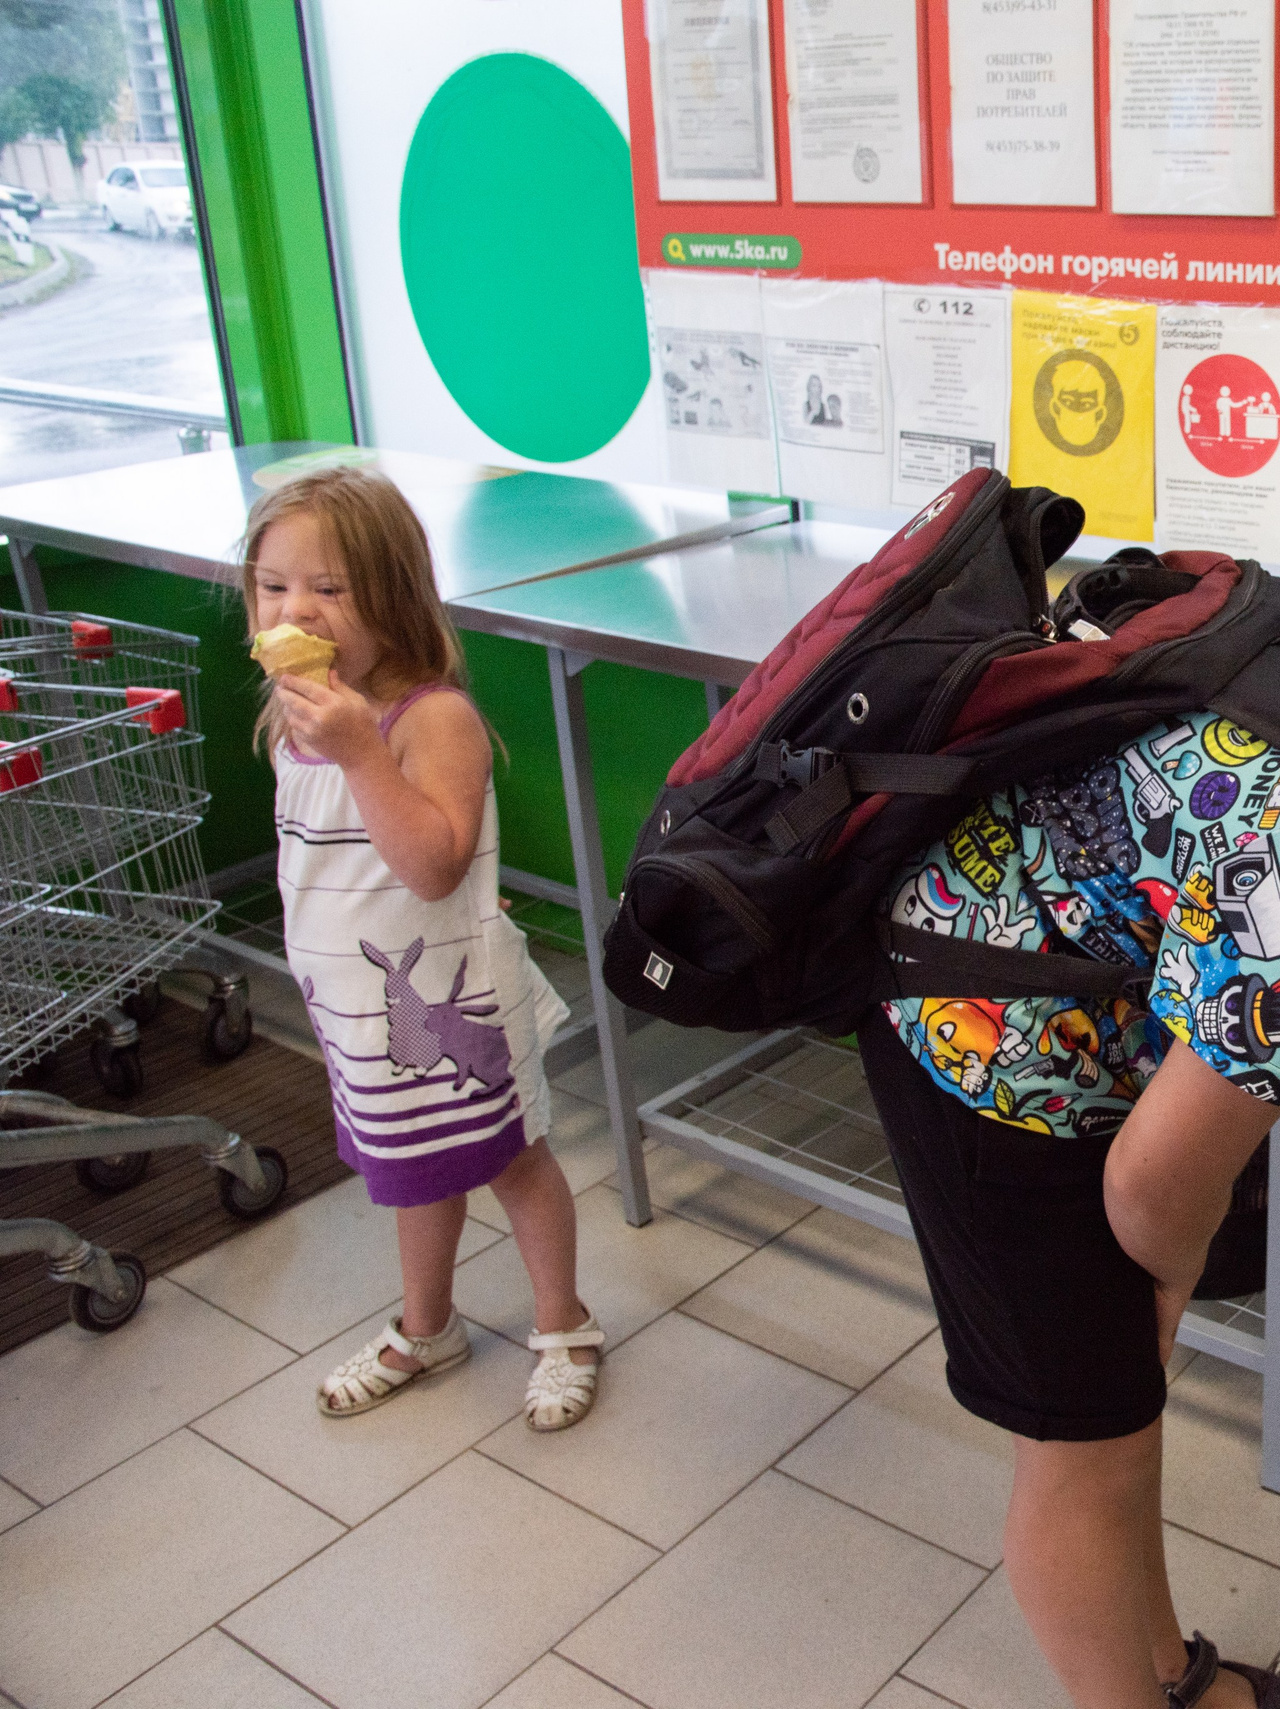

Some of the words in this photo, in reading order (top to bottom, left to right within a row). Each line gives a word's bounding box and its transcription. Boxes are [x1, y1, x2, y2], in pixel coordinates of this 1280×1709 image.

[986, 53, 1053, 66] ОБЩЕСТВО
[986, 71, 1004, 84] ПО
[1008, 70, 1056, 84] ЗАЩИТЕ
[1006, 88, 1036, 101] ПРАВ
[977, 103, 1068, 118] ПОТРЕБИТЕЛЕЙ
[689, 238, 788, 261] www.5ka.ru
[934, 242, 1054, 280] Телефон
[1061, 252, 1180, 285] горячей
[939, 301, 973, 316] 112
[1161, 328, 1223, 342] соблюдайте
[1162, 340, 1221, 353] дистанцию!
[1211, 825, 1223, 844] WE
